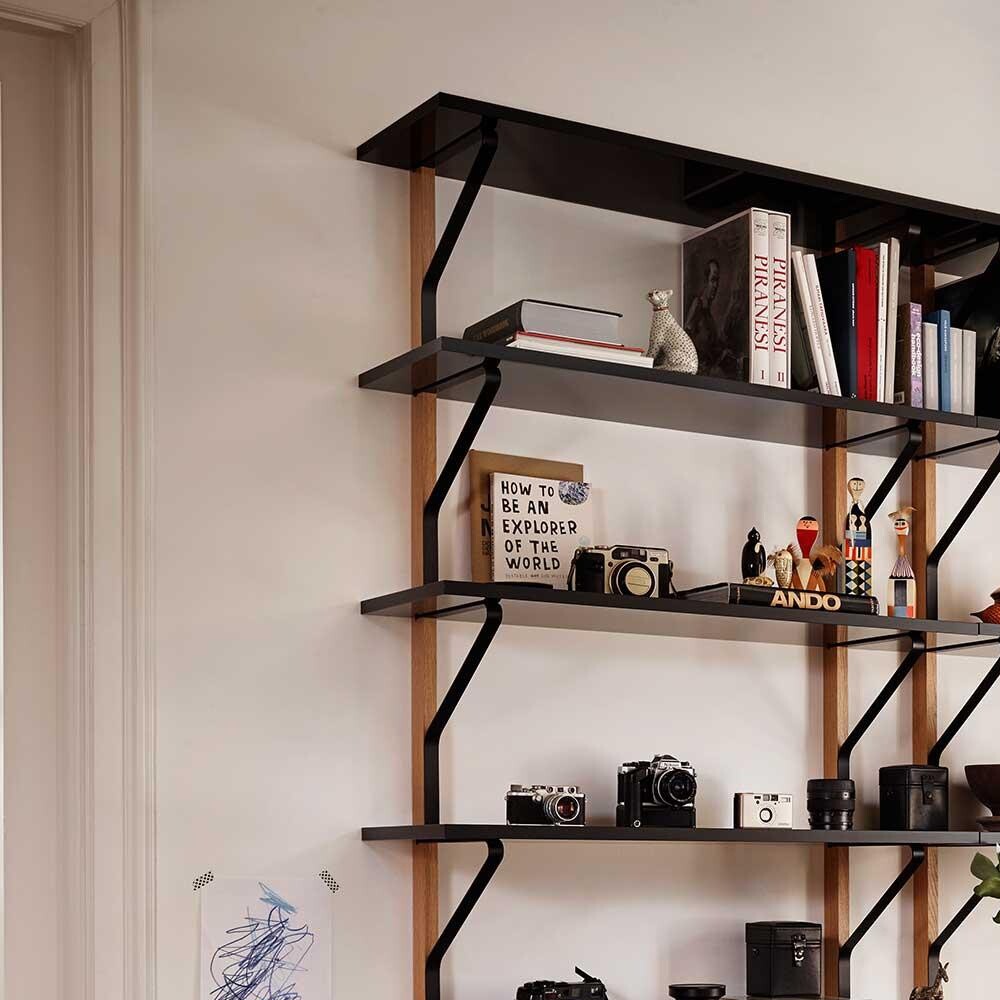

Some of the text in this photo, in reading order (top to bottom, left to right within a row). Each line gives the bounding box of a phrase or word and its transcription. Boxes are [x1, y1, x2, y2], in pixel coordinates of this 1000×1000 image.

[754, 254, 769, 351] PIRANESI
[773, 256, 787, 353] PIRANESI
[777, 371, 785, 382] II
[501, 480, 555, 497] HOW TO
[501, 499, 520, 514] BE
[527, 500, 549, 515] AN
[502, 519, 578, 535] EXPLORER
[504, 538, 523, 553] OF
[529, 540, 559, 554] THE
[506, 556, 561, 571] WORLD
[769, 590, 842, 611] ANDO
